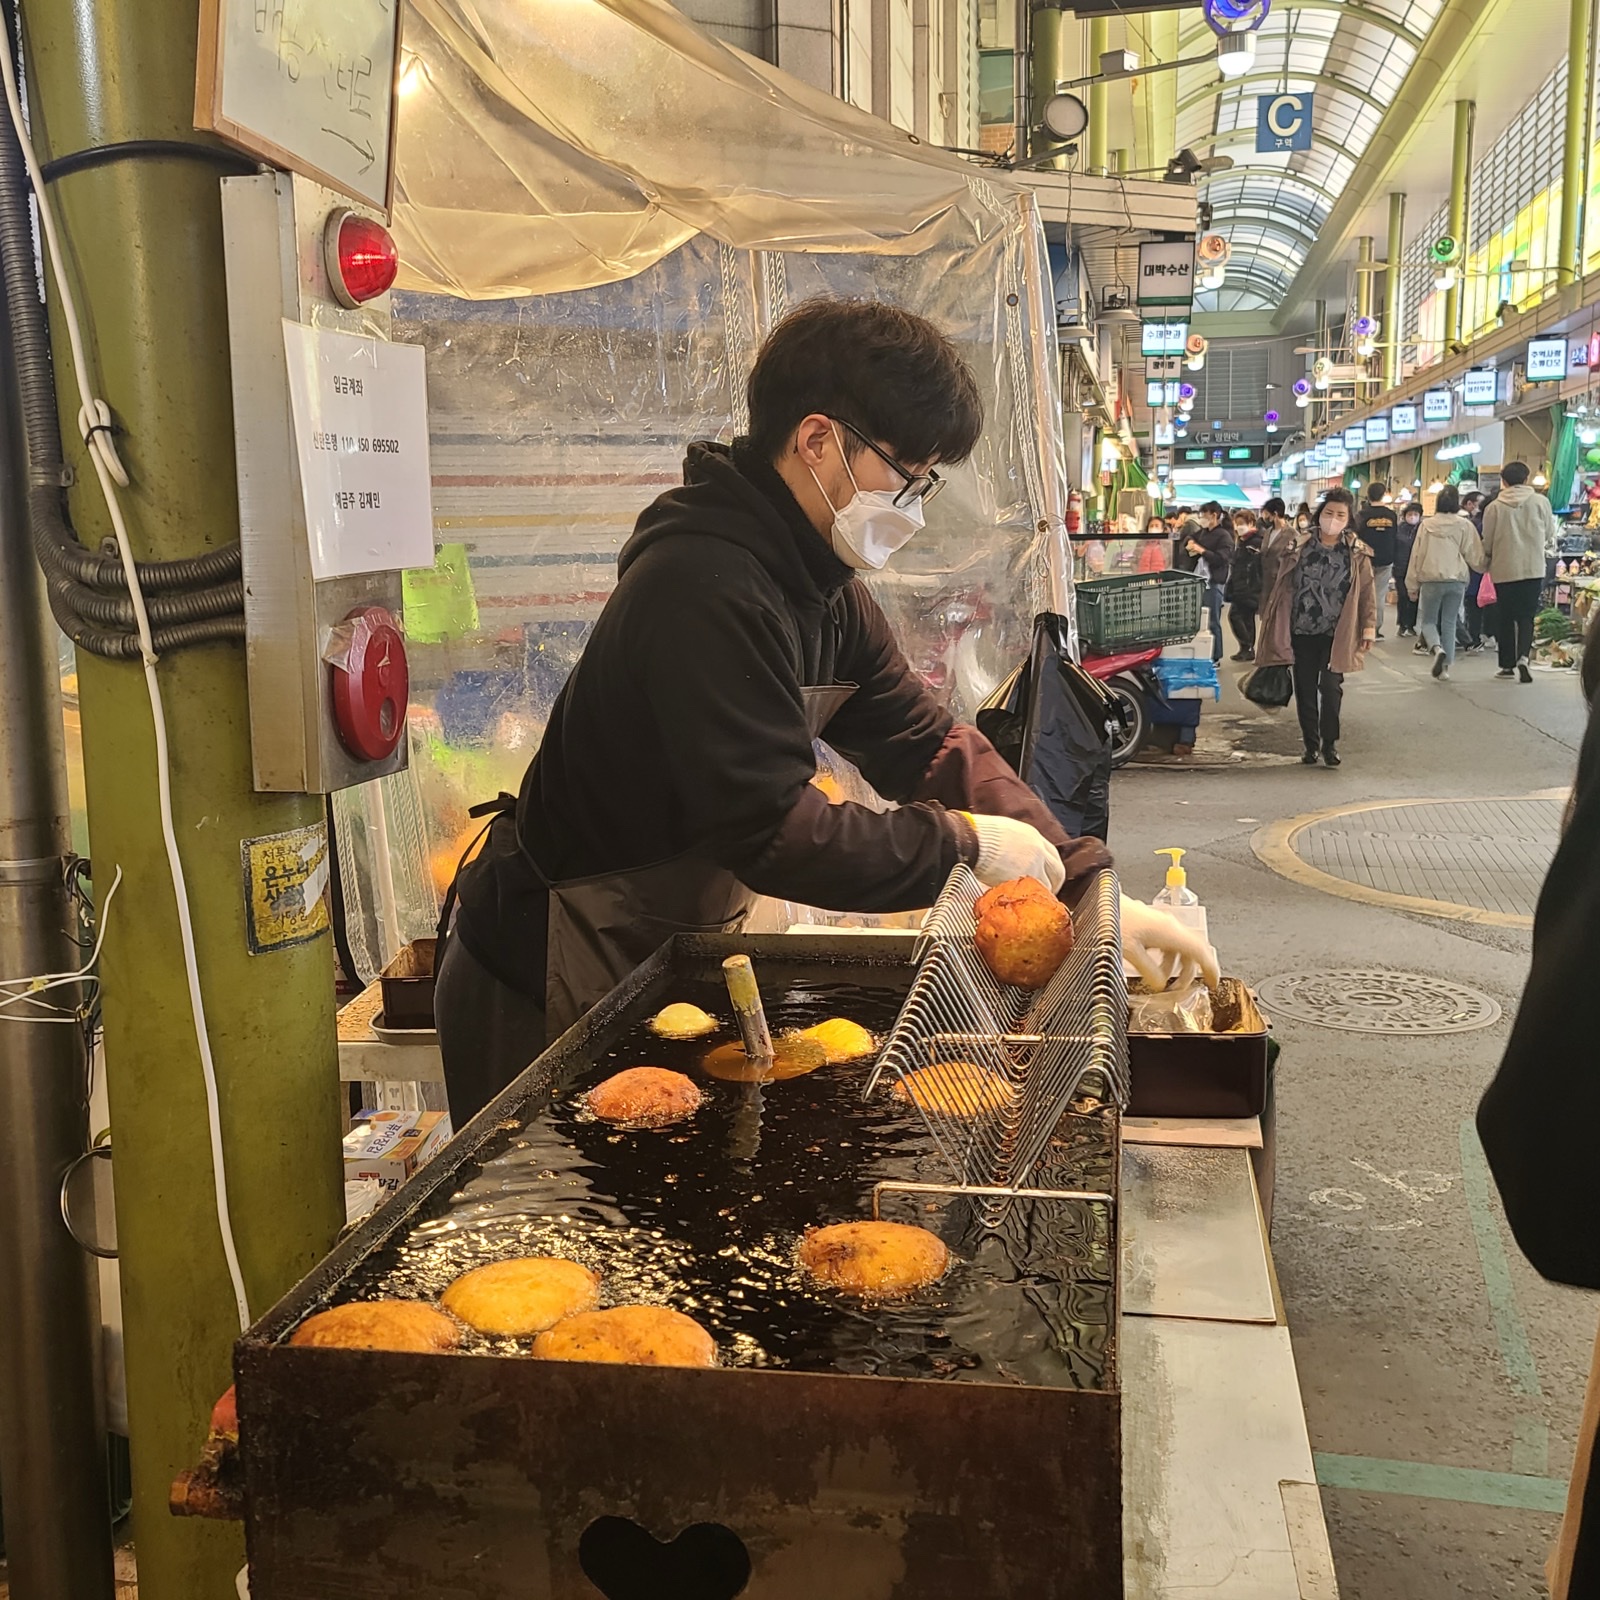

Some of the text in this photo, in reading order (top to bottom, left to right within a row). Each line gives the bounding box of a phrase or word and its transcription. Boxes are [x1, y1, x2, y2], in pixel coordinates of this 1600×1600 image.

[1267, 95, 1303, 137] C
[1275, 138, 1293, 149] 구역
[1143, 263, 1190, 277] 대박수산
[333, 375, 364, 396] 입금계좌
[313, 431, 338, 452] 신한은행
[341, 436, 354, 451] 110
[372, 438, 399, 453] 695502
[334, 491, 381, 510] 예금주 김재민
